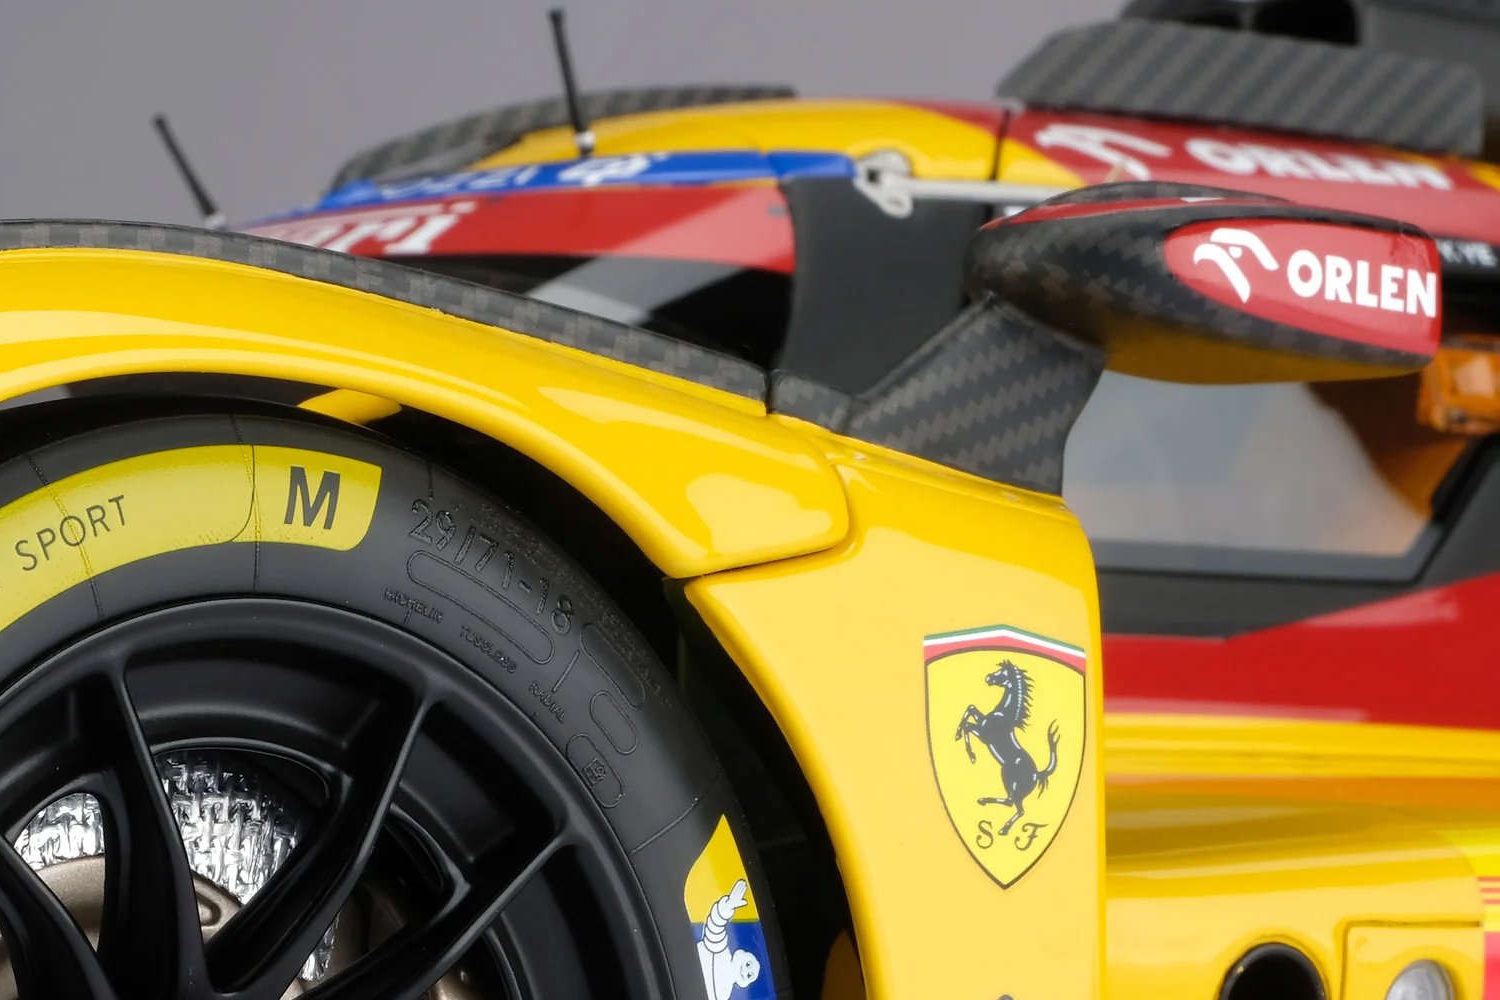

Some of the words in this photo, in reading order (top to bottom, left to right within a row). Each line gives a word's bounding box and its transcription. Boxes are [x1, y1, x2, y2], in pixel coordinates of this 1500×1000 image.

[1185, 137, 1455, 192] ORLEN
[1287, 249, 1437, 318] ORLEN
[283, 465, 341, 531] M
[14, 494, 128, 572] SPORT
[383, 587, 445, 625] MICHELIN
